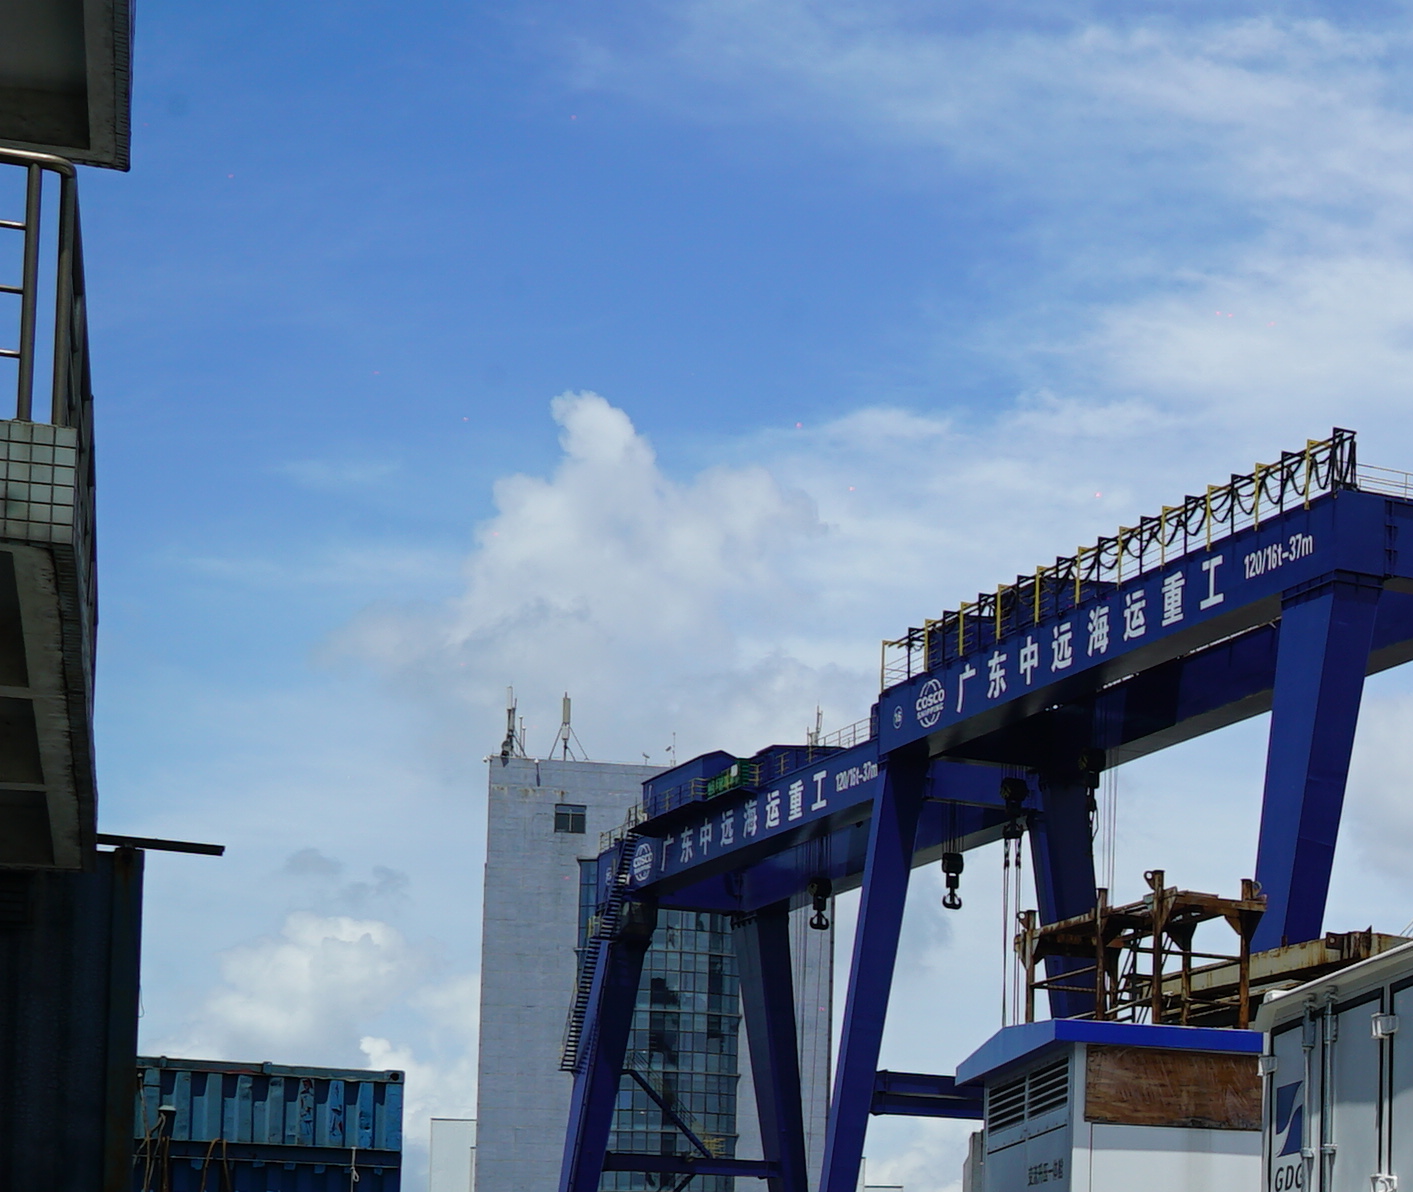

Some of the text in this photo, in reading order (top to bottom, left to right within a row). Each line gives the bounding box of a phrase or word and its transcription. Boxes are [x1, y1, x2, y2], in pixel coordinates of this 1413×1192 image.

[1244, 533, 1314, 580] 120/16t-37m
[957, 555, 1224, 713] 广东中远海运重工
[916, 688, 945, 712] COSCO
[661, 769, 828, 871] 广东中远海运重工
